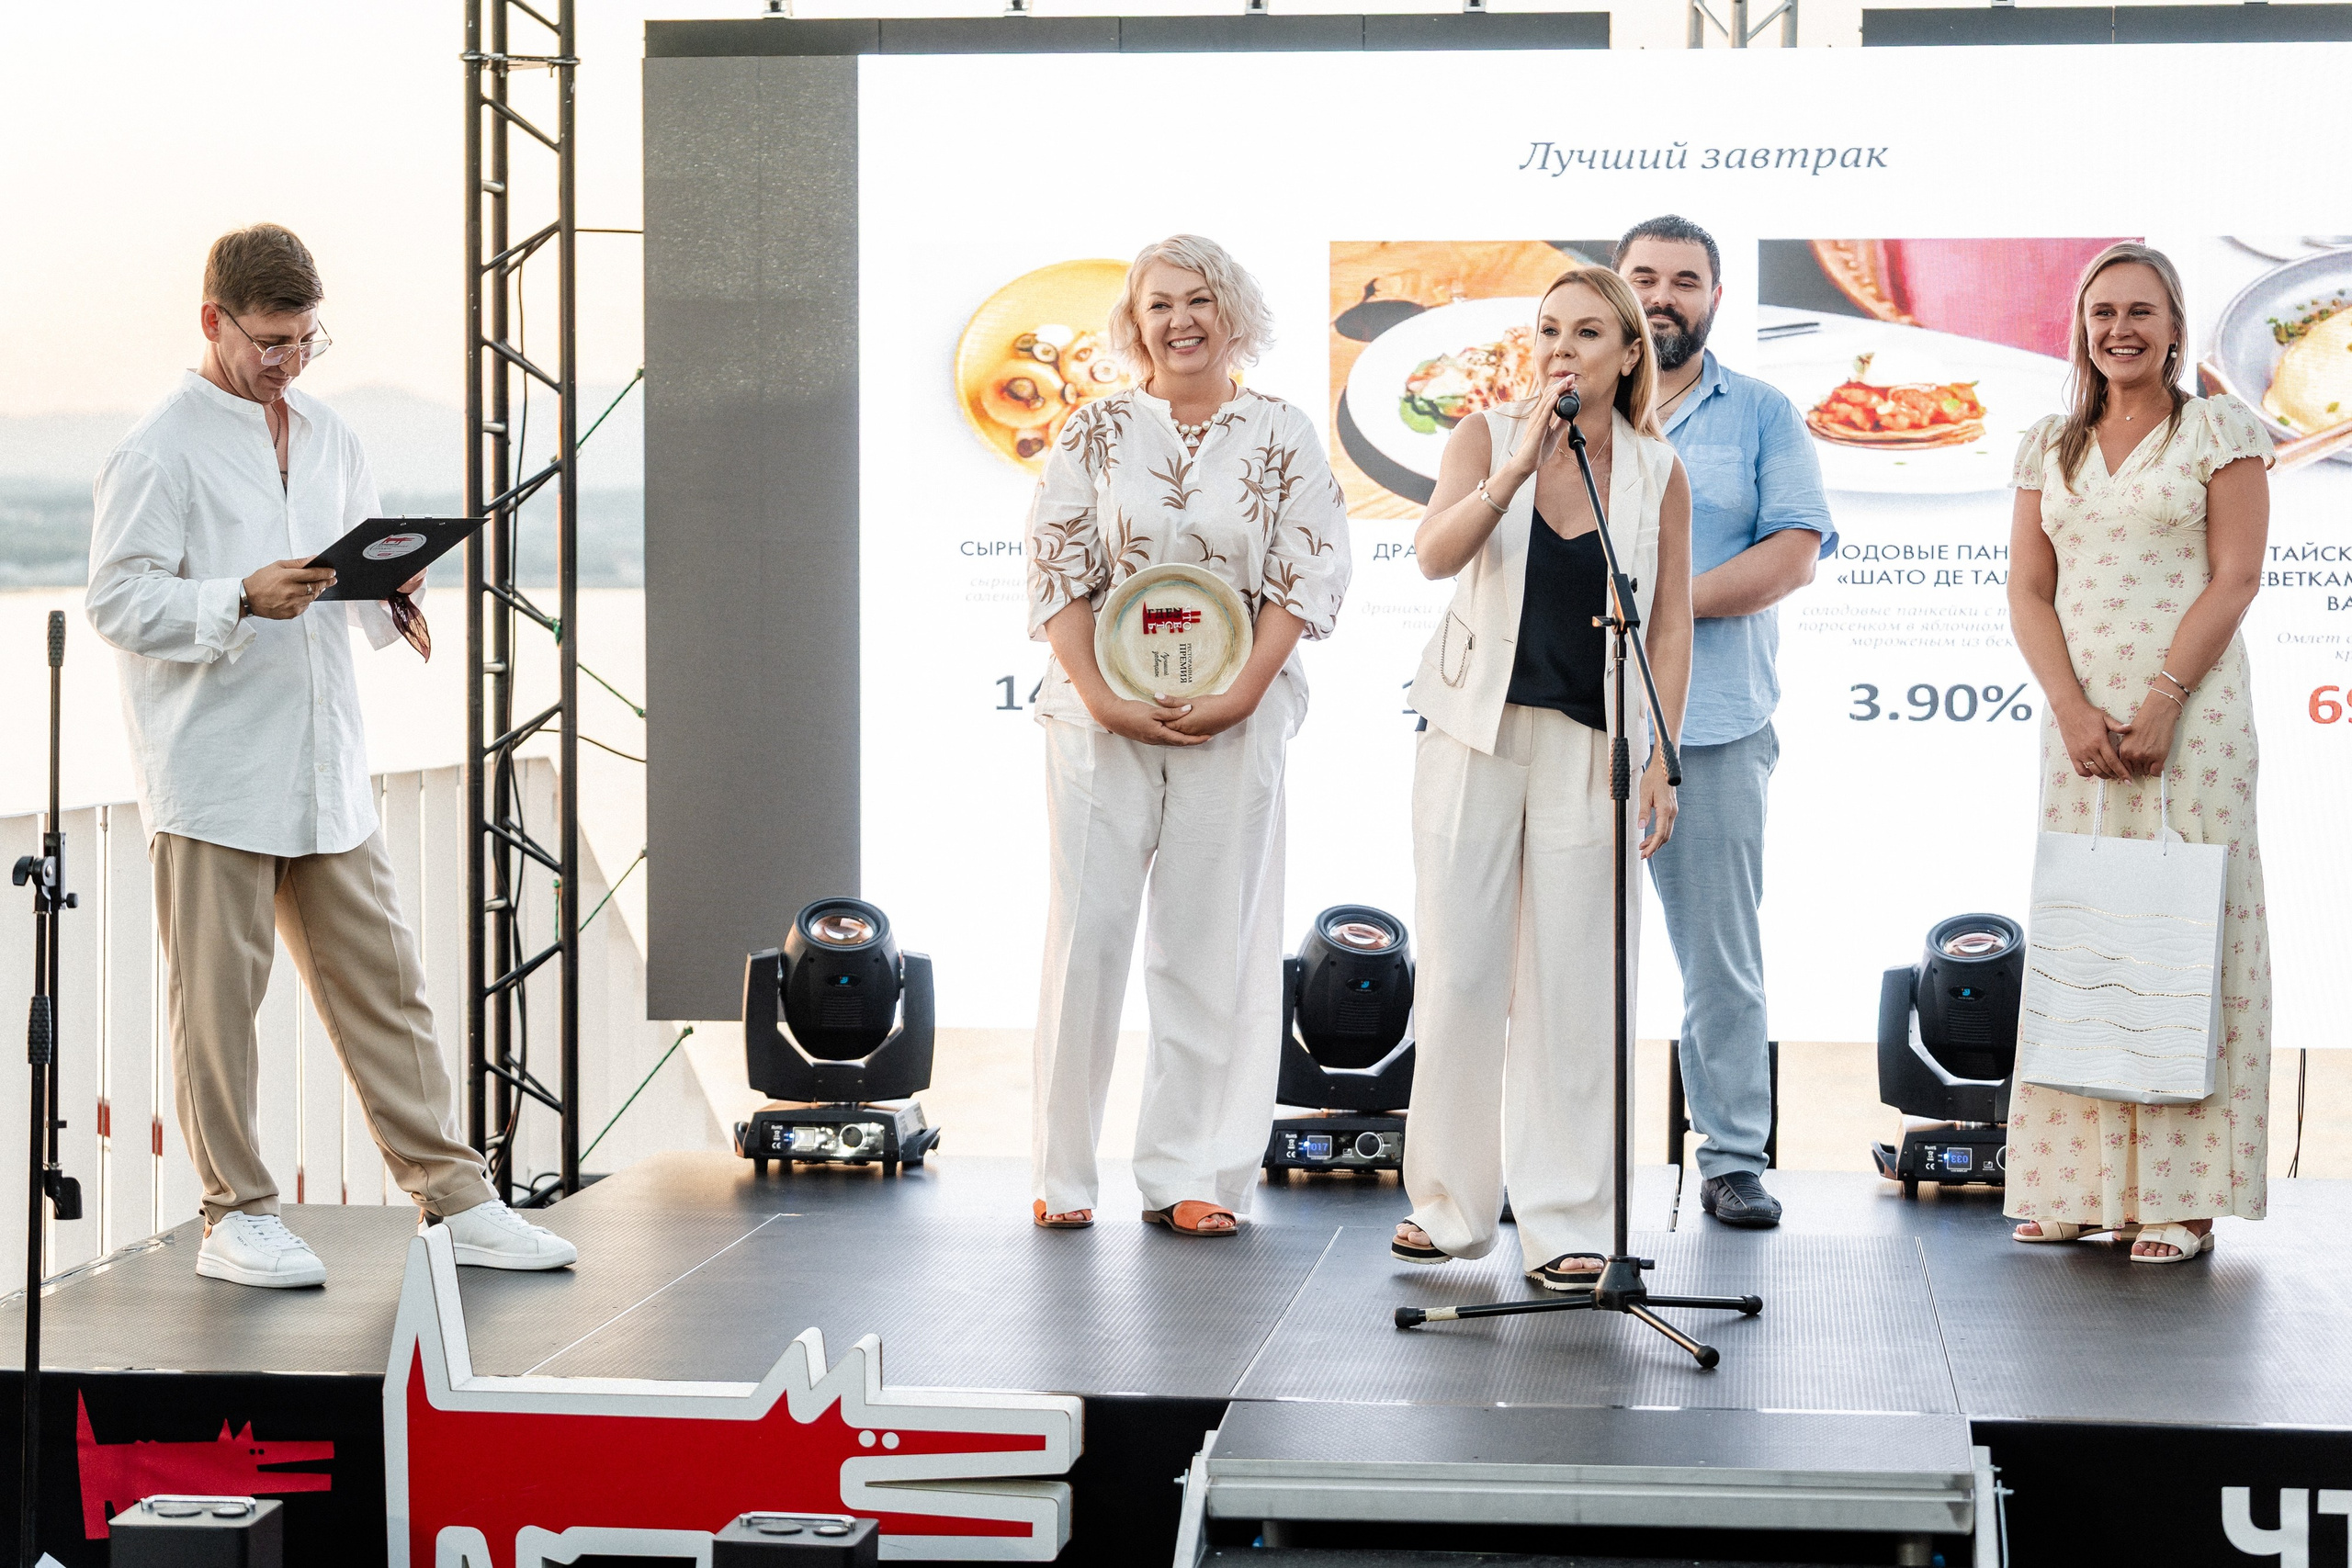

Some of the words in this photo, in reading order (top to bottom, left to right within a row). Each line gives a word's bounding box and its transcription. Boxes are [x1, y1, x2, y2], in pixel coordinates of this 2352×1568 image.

[1519, 141, 1688, 177] Лучший
[1701, 145, 1889, 176] завтрак
[960, 541, 1027, 556] СЫРН
[1958, 544, 2008, 559] ПАН
[2269, 541, 2352, 561] ТАЙСК
[970, 578, 1026, 590] сырни
[1837, 569, 1926, 585] «ШАТО
[1934, 569, 1963, 587] ДЕ
[1802, 604, 1891, 616] солодовые
[1897, 604, 1979, 616] панкейки
[1798, 621, 1901, 634] поросенком
[1920, 619, 2005, 632] яблочном
[1850, 637, 1956, 649] мороженым
[1962, 637, 1980, 648] из
[2277, 632, 2340, 644] Омлет
[1849, 682, 2032, 722] 3.90%
[2308, 684, 2352, 725] 6
[1311, 1143, 1329, 1151] 017
